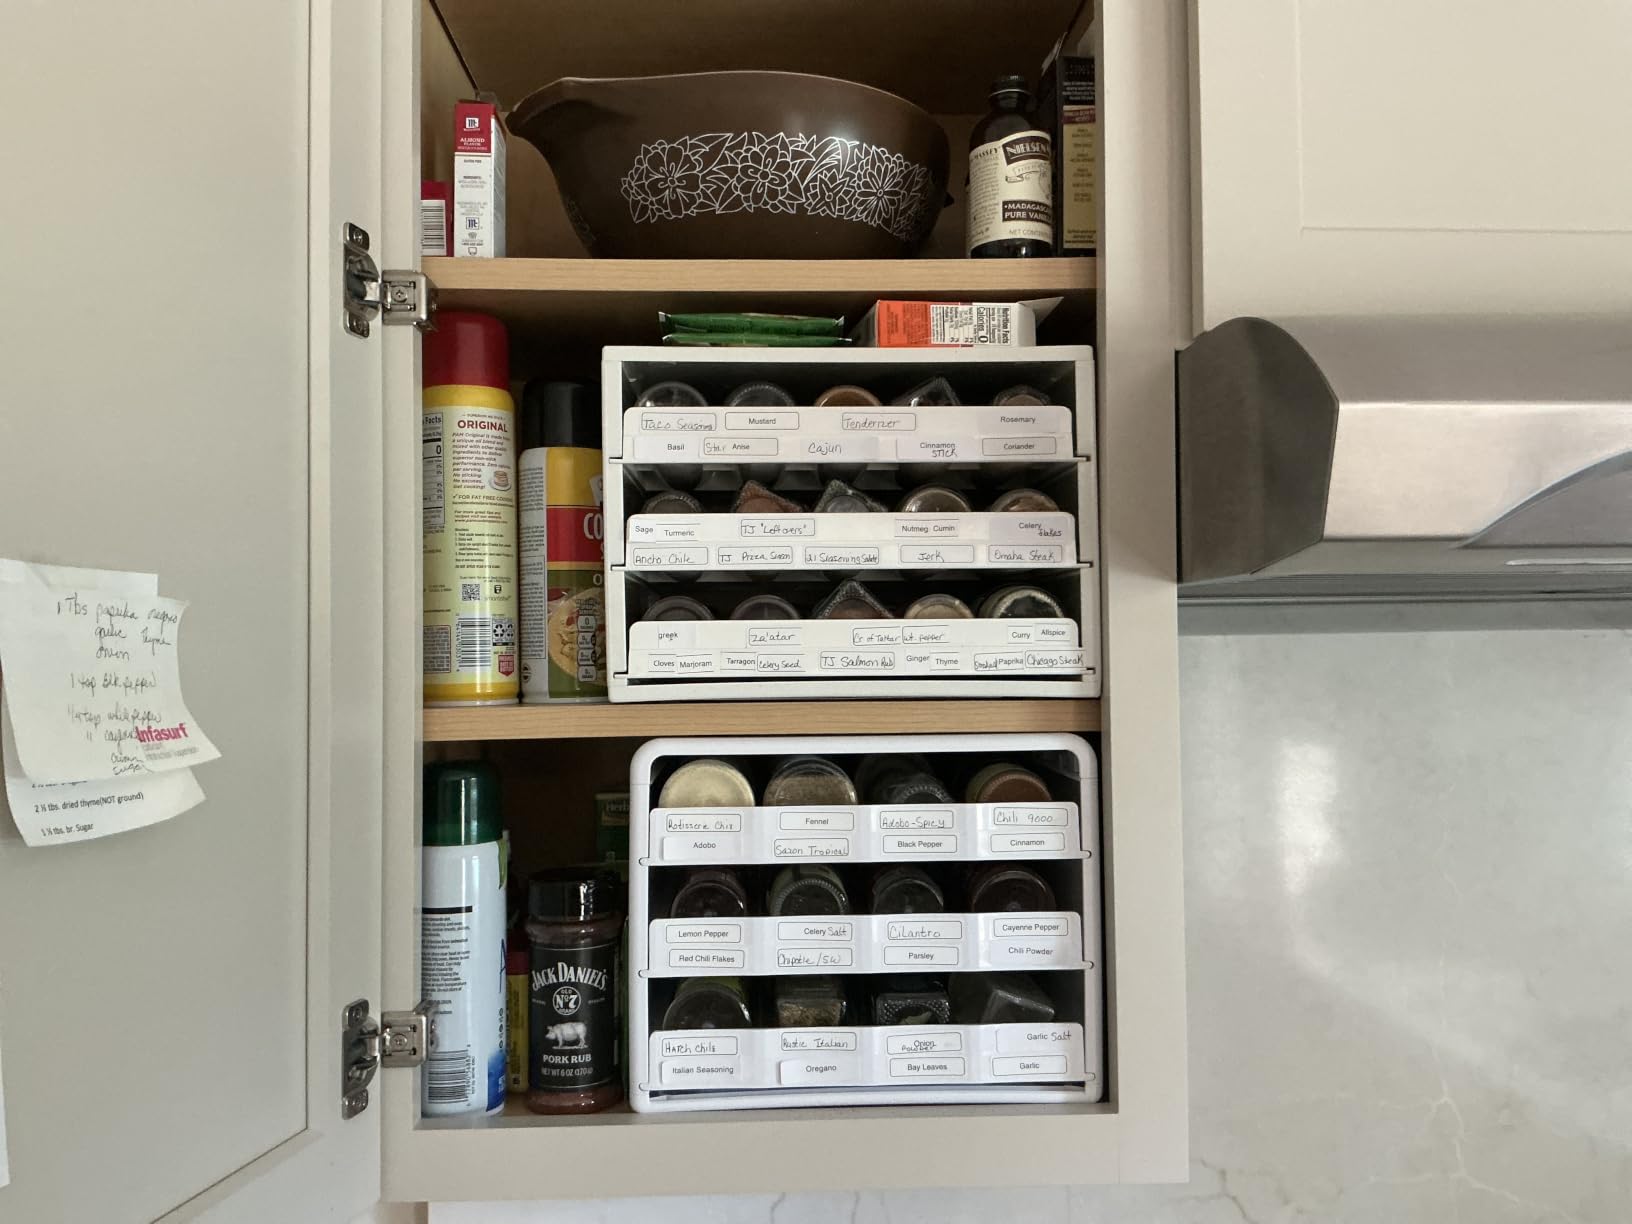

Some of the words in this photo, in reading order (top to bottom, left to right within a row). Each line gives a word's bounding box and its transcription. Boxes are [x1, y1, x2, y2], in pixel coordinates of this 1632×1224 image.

[1005, 211, 1027, 219] PURE
[977, 306, 985, 332] Calories
[1002, 307, 1010, 330] Nutrition
[978, 335, 988, 343] 0
[1002, 330, 1010, 344] Facts
[425, 415, 442, 425] Facts
[643, 418, 671, 430] Taco
[1000, 416, 1036, 425] Rosemary
[457, 419, 508, 433] ORIGINAL
[436, 444, 442, 455] 0
[808, 443, 843, 456] Cajun
[635, 526, 654, 534] Sage
[741, 525, 755, 535] TJ
[902, 525, 929, 533] Nutmeg
[1019, 522, 1042, 531] Celery
[664, 529, 695, 537] Turmeric
[635, 555, 662, 565] Ancho
[994, 550, 1024, 561] Omaha
[658, 632, 678, 641] greek
[1011, 631, 1031, 640] Curry
[1041, 628, 1066, 637] Allspice
[866, 634, 875, 642] of
[653, 659, 675, 667] Cloves
[727, 657, 756, 666] Tarragon
[821, 656, 835, 667] TJ
[841, 655, 879, 668] Salmon
[906, 655, 930, 664] Ginger
[935, 657, 959, 666] Thyme
[998, 657, 1024, 666] Paprika
[1027, 654, 1058, 668] Chicago
[679, 660, 713, 669] Marjoram
[135, 722, 189, 743] Infasurf
[34, 804, 40, 813] 2
[62, 799, 79, 810] dried
[117, 791, 144, 804] ground)
[805, 817, 829, 825] Fennel
[996, 810, 1019, 823] Chili
[1027, 813, 1053, 823] 9000
[76, 823, 94, 833] Sugar
[692, 841, 717, 849] Adobo
[897, 840, 917, 848] Black
[918, 840, 943, 849] Pepper
[1009, 839, 1045, 847] Cinnamon
[807, 845, 849, 856] Tropical
[803, 927, 826, 936] Celery
[827, 926, 847, 937] Salt
[1002, 923, 1033, 932] Cayenne
[1034, 923, 1060, 932] Pepper
[678, 930, 702, 938] Lemon
[703, 930, 729, 939] Pepper
[1008, 946, 1025, 955] Chili
[1025, 947, 1054, 956] Powder
[678, 955, 694, 963] Red
[695, 955, 711, 963] Chili
[712, 955, 735, 963] Flakes
[908, 952, 934, 961] Parsley
[531, 967, 558, 991] JACK
[557, 961, 608, 991] DANIEL'S
[1027, 1033, 1048, 1041] Garlic
[1050, 1031, 1071, 1042] Salt
[813, 1038, 849, 1049] Italian
[913, 1039, 935, 1048] Onion
[543, 1054, 569, 1064] PORK
[571, 1054, 592, 1063] RUB
[541, 1067, 550, 1076] NET
[551, 1068, 560, 1076] WT
[565, 1068, 574, 1076] OZ
[672, 1066, 694, 1074] Italian
[696, 1066, 734, 1075] Seasoning
[805, 1065, 837, 1073] Oregano
[907, 1063, 921, 1072] Bay
[922, 1063, 948, 1071] Leaves
